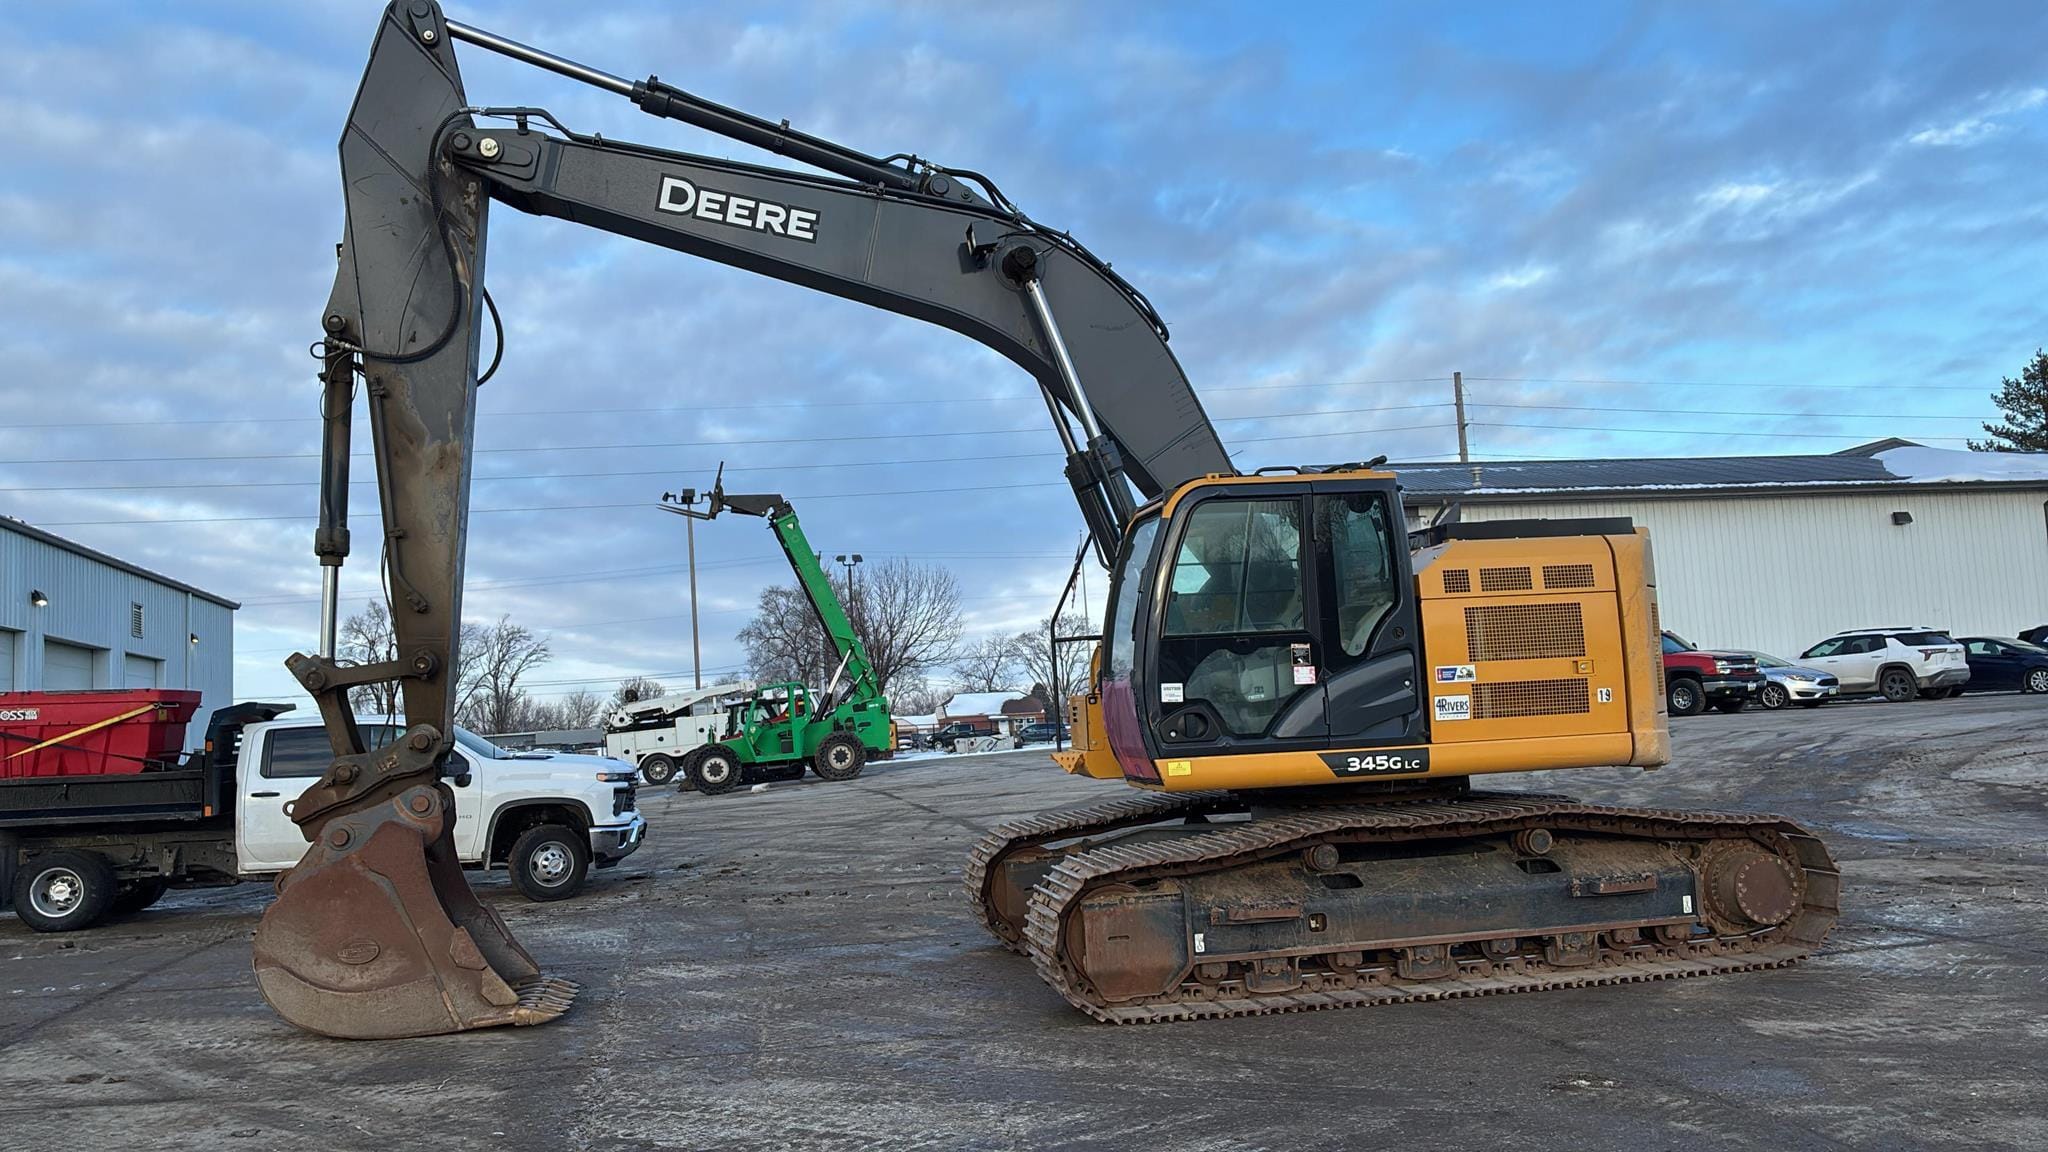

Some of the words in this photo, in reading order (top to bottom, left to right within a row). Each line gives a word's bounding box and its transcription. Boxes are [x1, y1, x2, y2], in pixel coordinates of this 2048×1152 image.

[657, 175, 818, 241] DEERE
[1599, 688, 1611, 702] 19
[0, 710, 24, 721] OSS
[1347, 755, 1402, 772] 345G
[1404, 759, 1421, 769] LC
